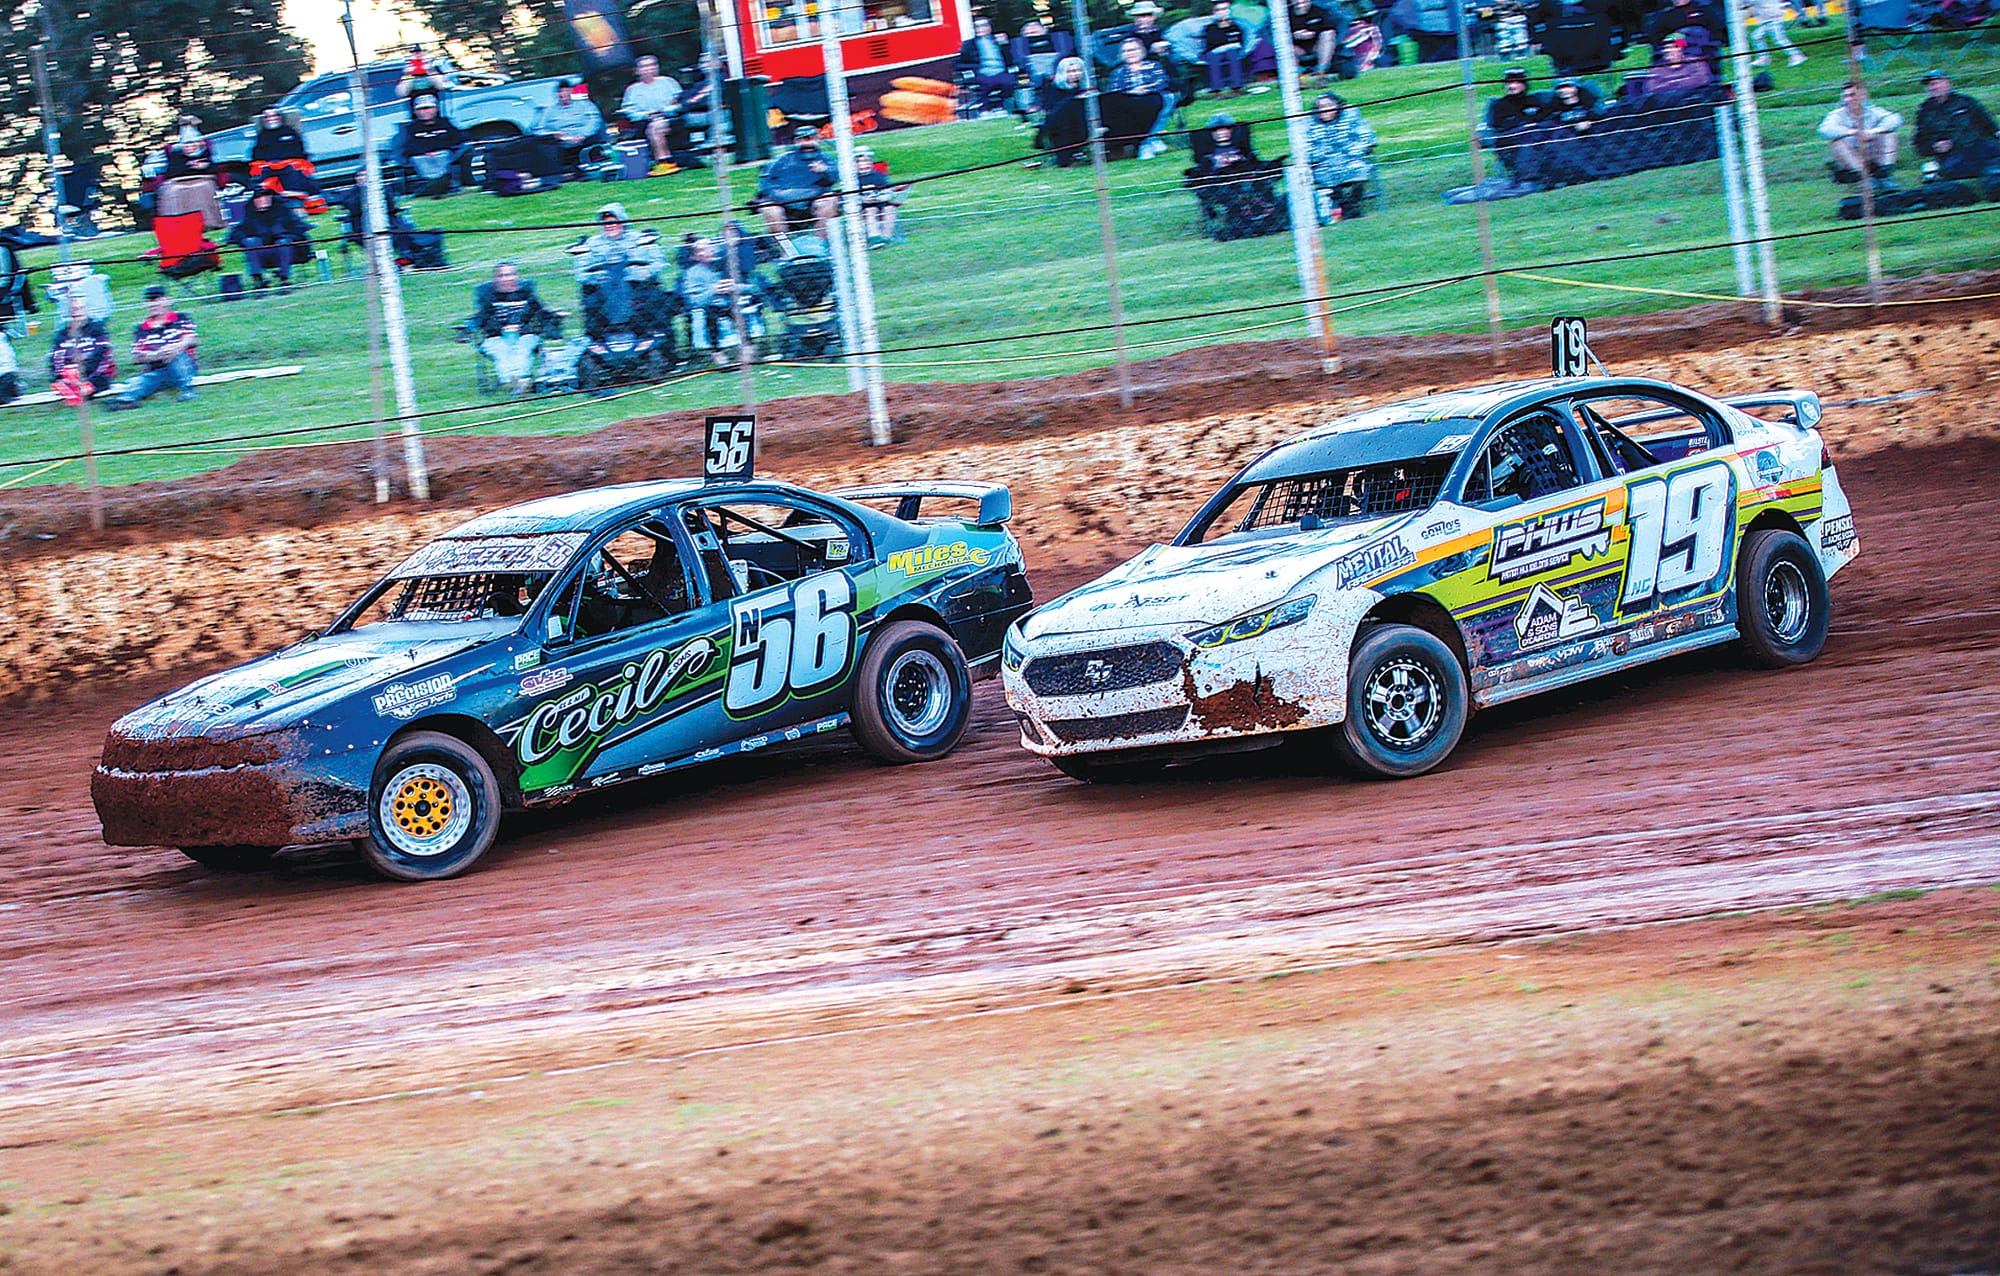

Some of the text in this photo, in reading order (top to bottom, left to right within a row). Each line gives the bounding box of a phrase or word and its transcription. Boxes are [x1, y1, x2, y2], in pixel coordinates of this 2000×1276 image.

[1553, 320, 1587, 377] 19
[706, 421, 753, 474] 56
[1621, 463, 1730, 604] 19
[889, 542, 968, 576] Miles
[1336, 535, 1412, 590] MENTAL
[726, 571, 851, 709] 56
[739, 607, 761, 648] N
[1531, 612, 1557, 628] ADAM
[1536, 622, 1558, 635] SONS
[515, 649, 540, 665] PACE
[374, 673, 453, 711] PRECISION
[521, 639, 714, 762] Cecil
[816, 718, 838, 732] PACE
